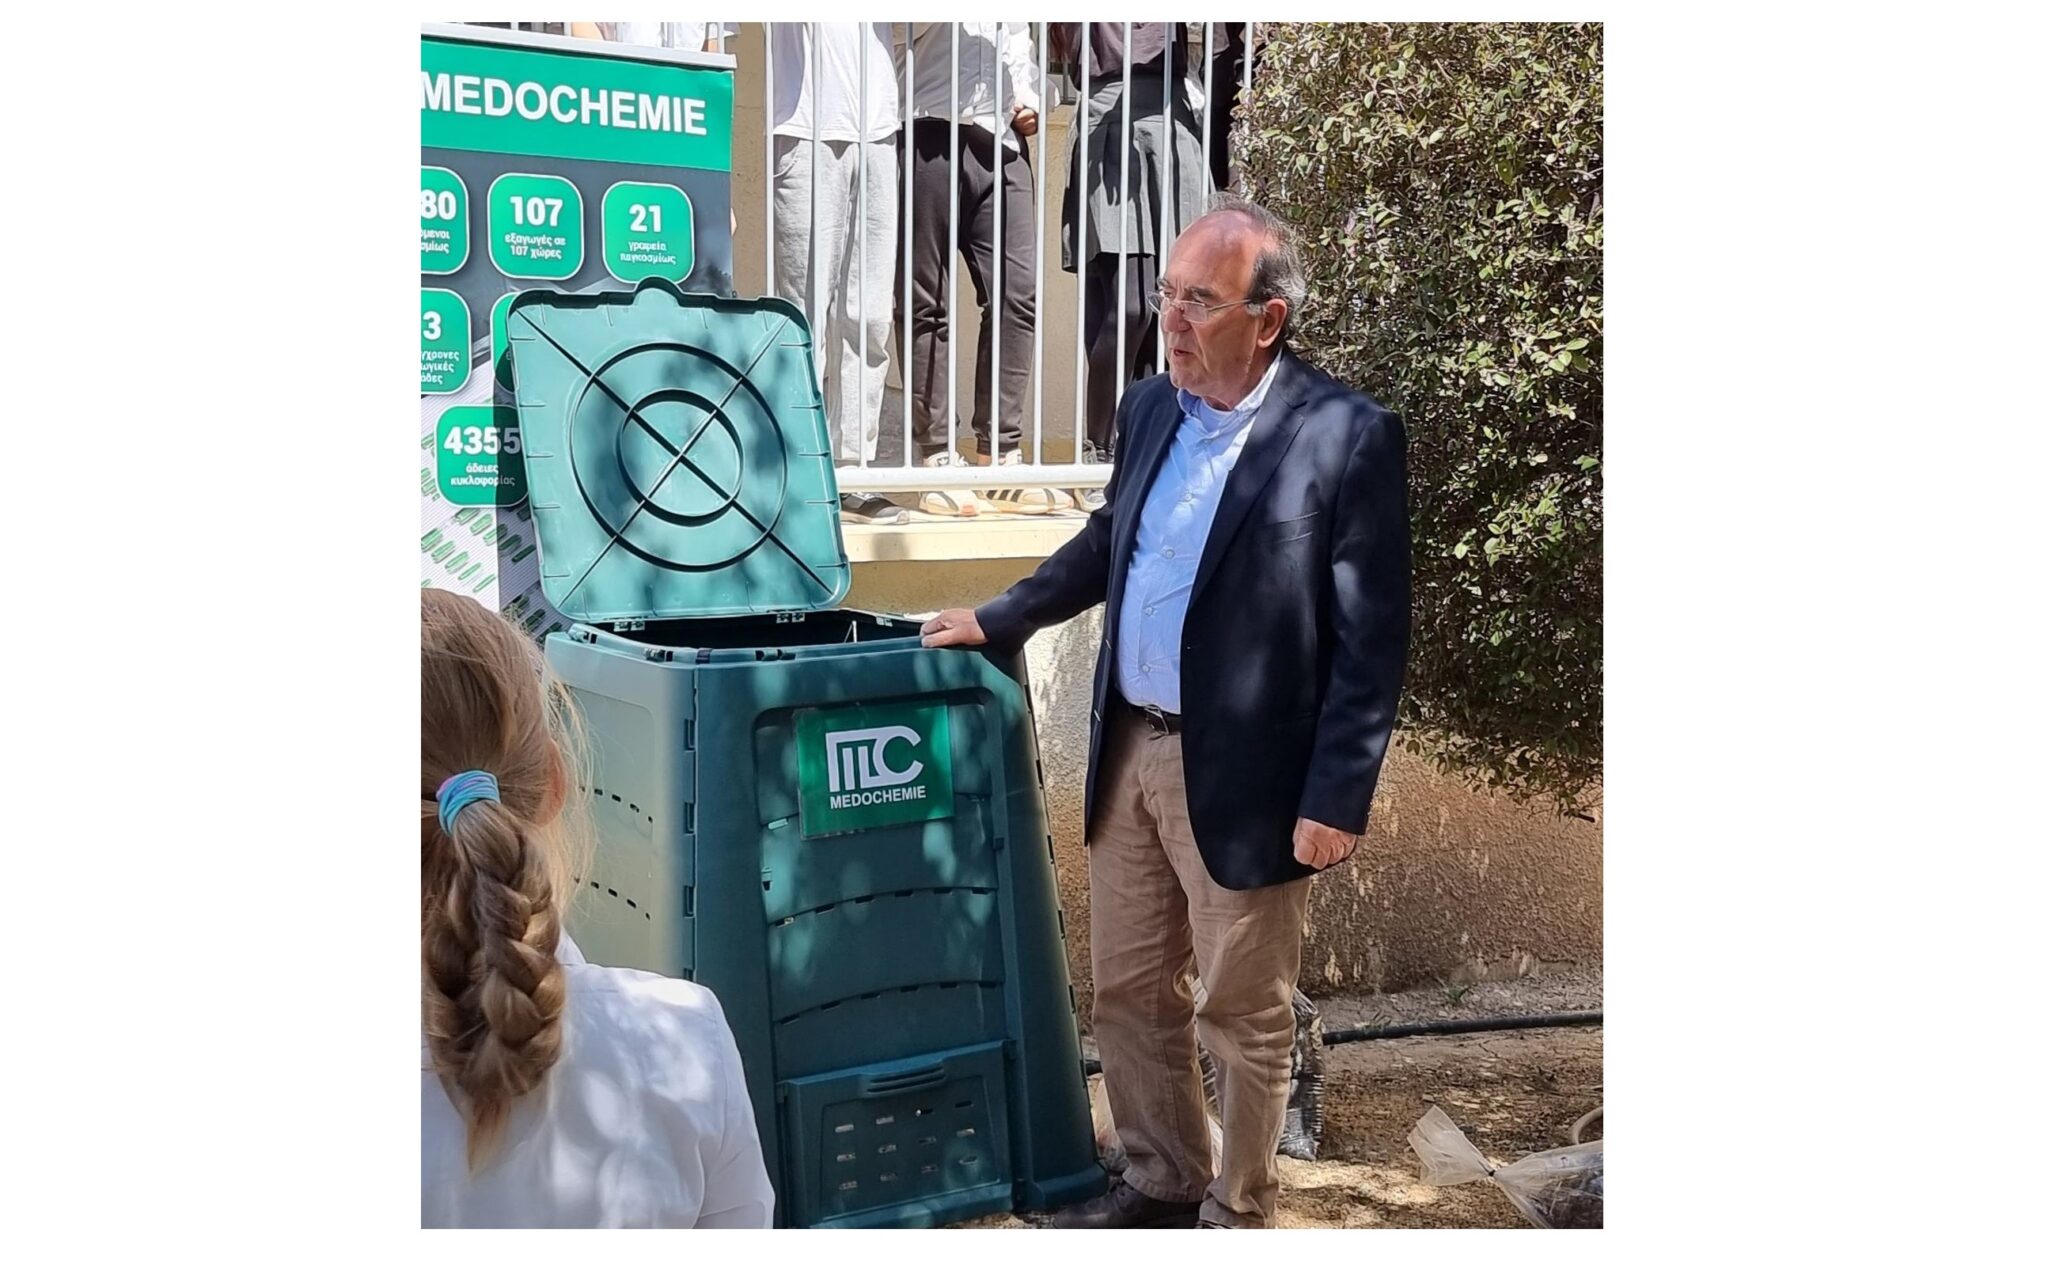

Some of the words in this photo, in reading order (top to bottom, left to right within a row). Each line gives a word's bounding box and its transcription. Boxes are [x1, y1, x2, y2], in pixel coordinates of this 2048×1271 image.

[421, 71, 707, 135] MEDOCHEMIE
[421, 189, 456, 220] 80
[510, 196, 563, 226] 107
[628, 204, 662, 232] 21
[505, 232, 553, 246] εξαγωγές
[554, 237, 567, 246] σε
[628, 240, 667, 252] γραφεία
[510, 245, 528, 256] 107
[530, 246, 562, 259] χώρες
[620, 252, 676, 264] παγκοσμίως
[443, 426, 521, 455] 4355
[466, 462, 499, 474] άδειες
[450, 474, 516, 487] κυκλοφορίας
[830, 785, 927, 809] MEDOCHEMIE
